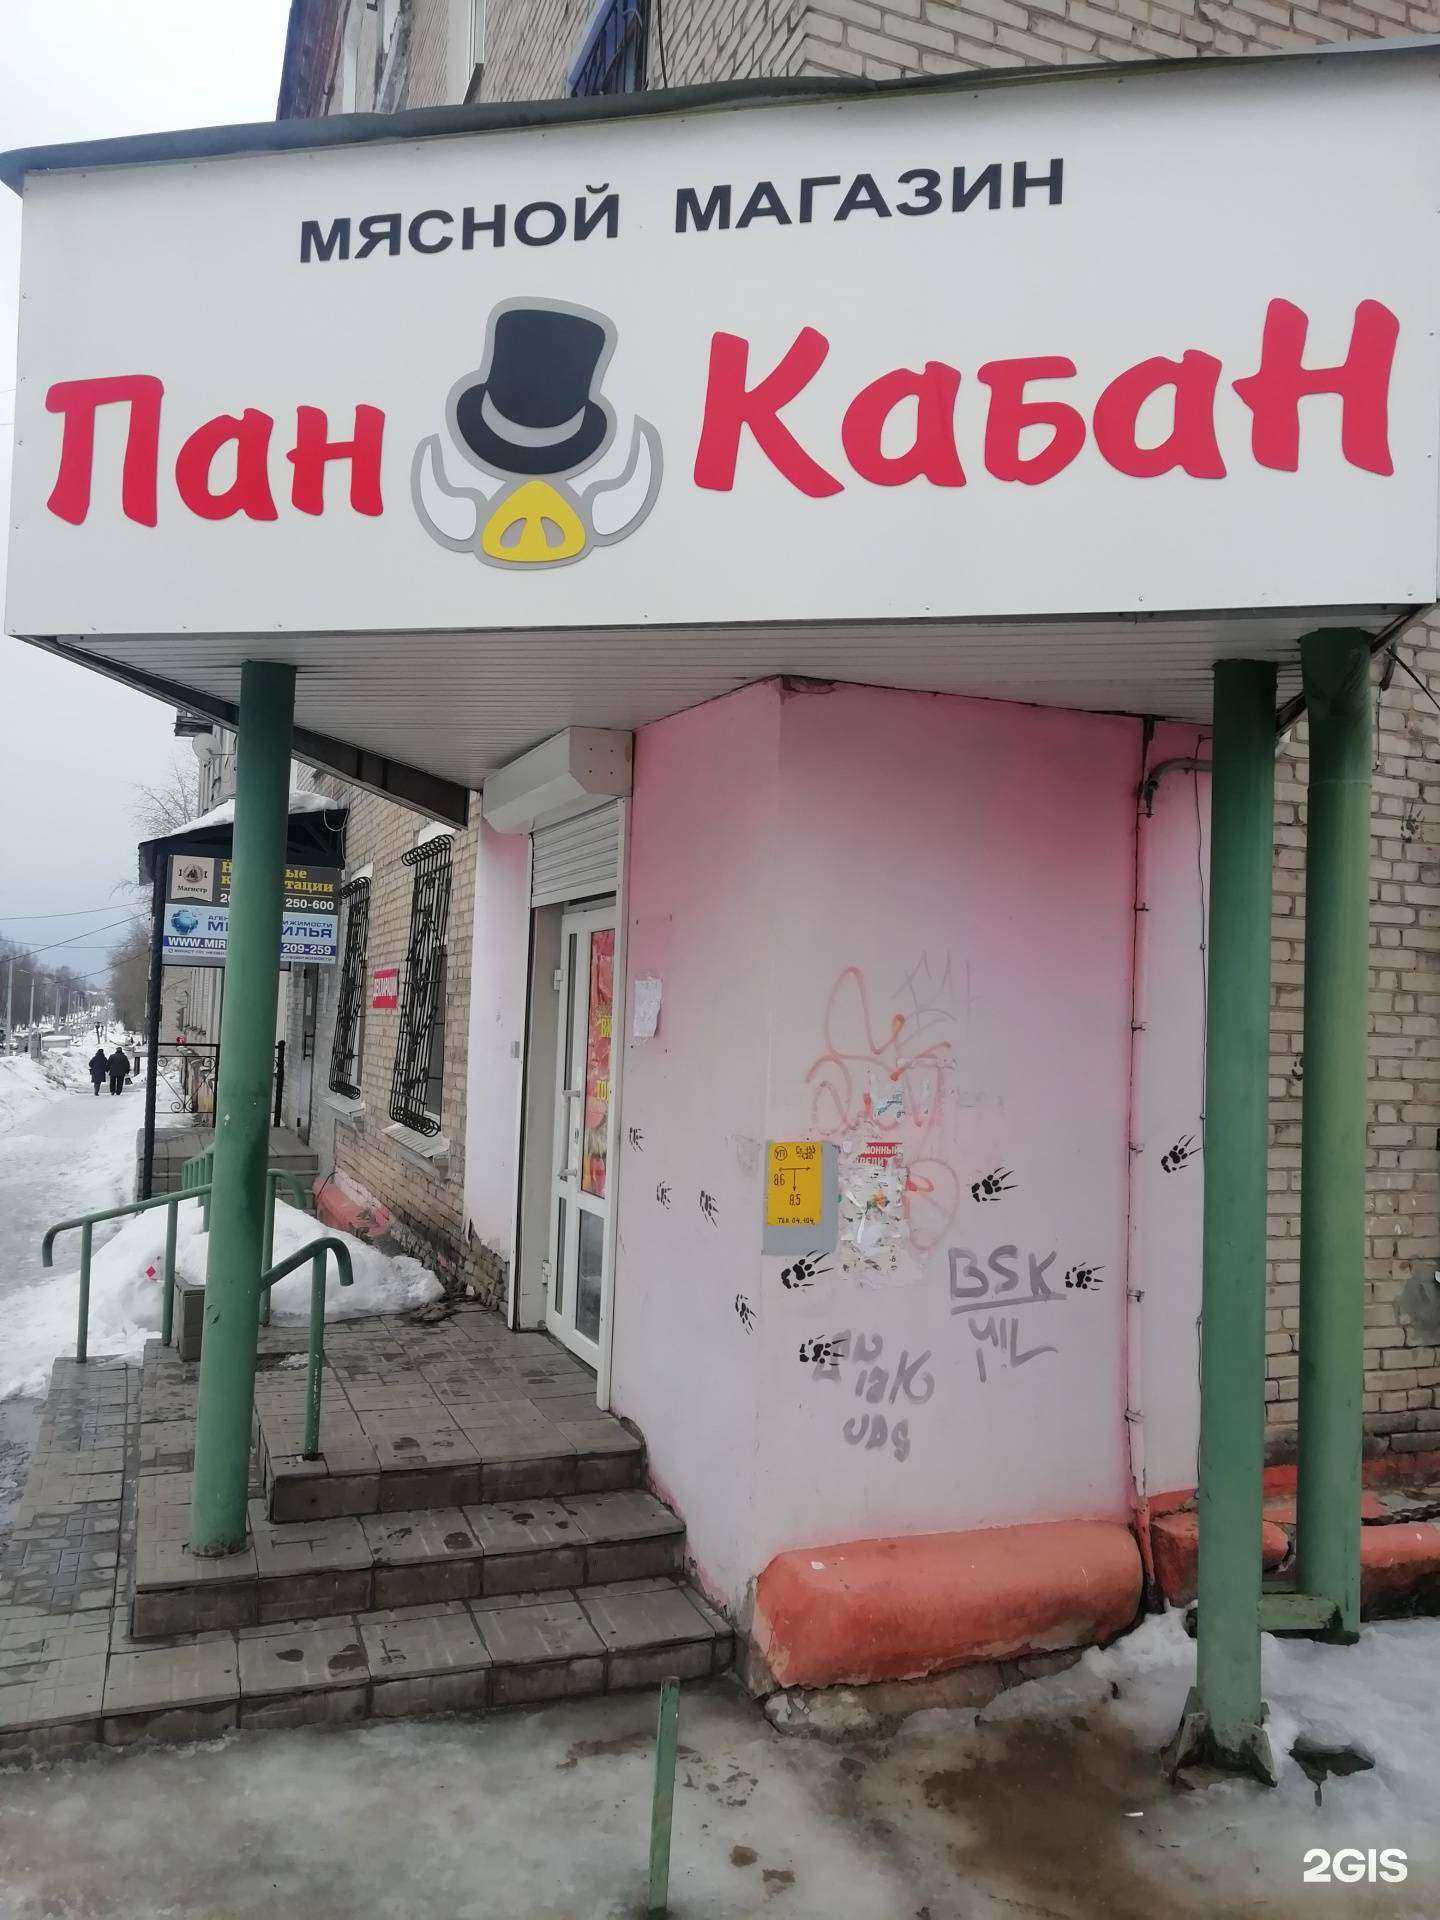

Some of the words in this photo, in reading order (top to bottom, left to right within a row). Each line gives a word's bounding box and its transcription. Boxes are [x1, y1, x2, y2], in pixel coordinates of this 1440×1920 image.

[300, 184, 621, 263] МЯСНОЙ
[675, 158, 1064, 233] МАГАЗИН
[45, 374, 386, 528] Пан
[177, 885, 208, 894] Магистр
[285, 898, 334, 911] 250-600
[948, 1245, 1057, 1301] BSK
